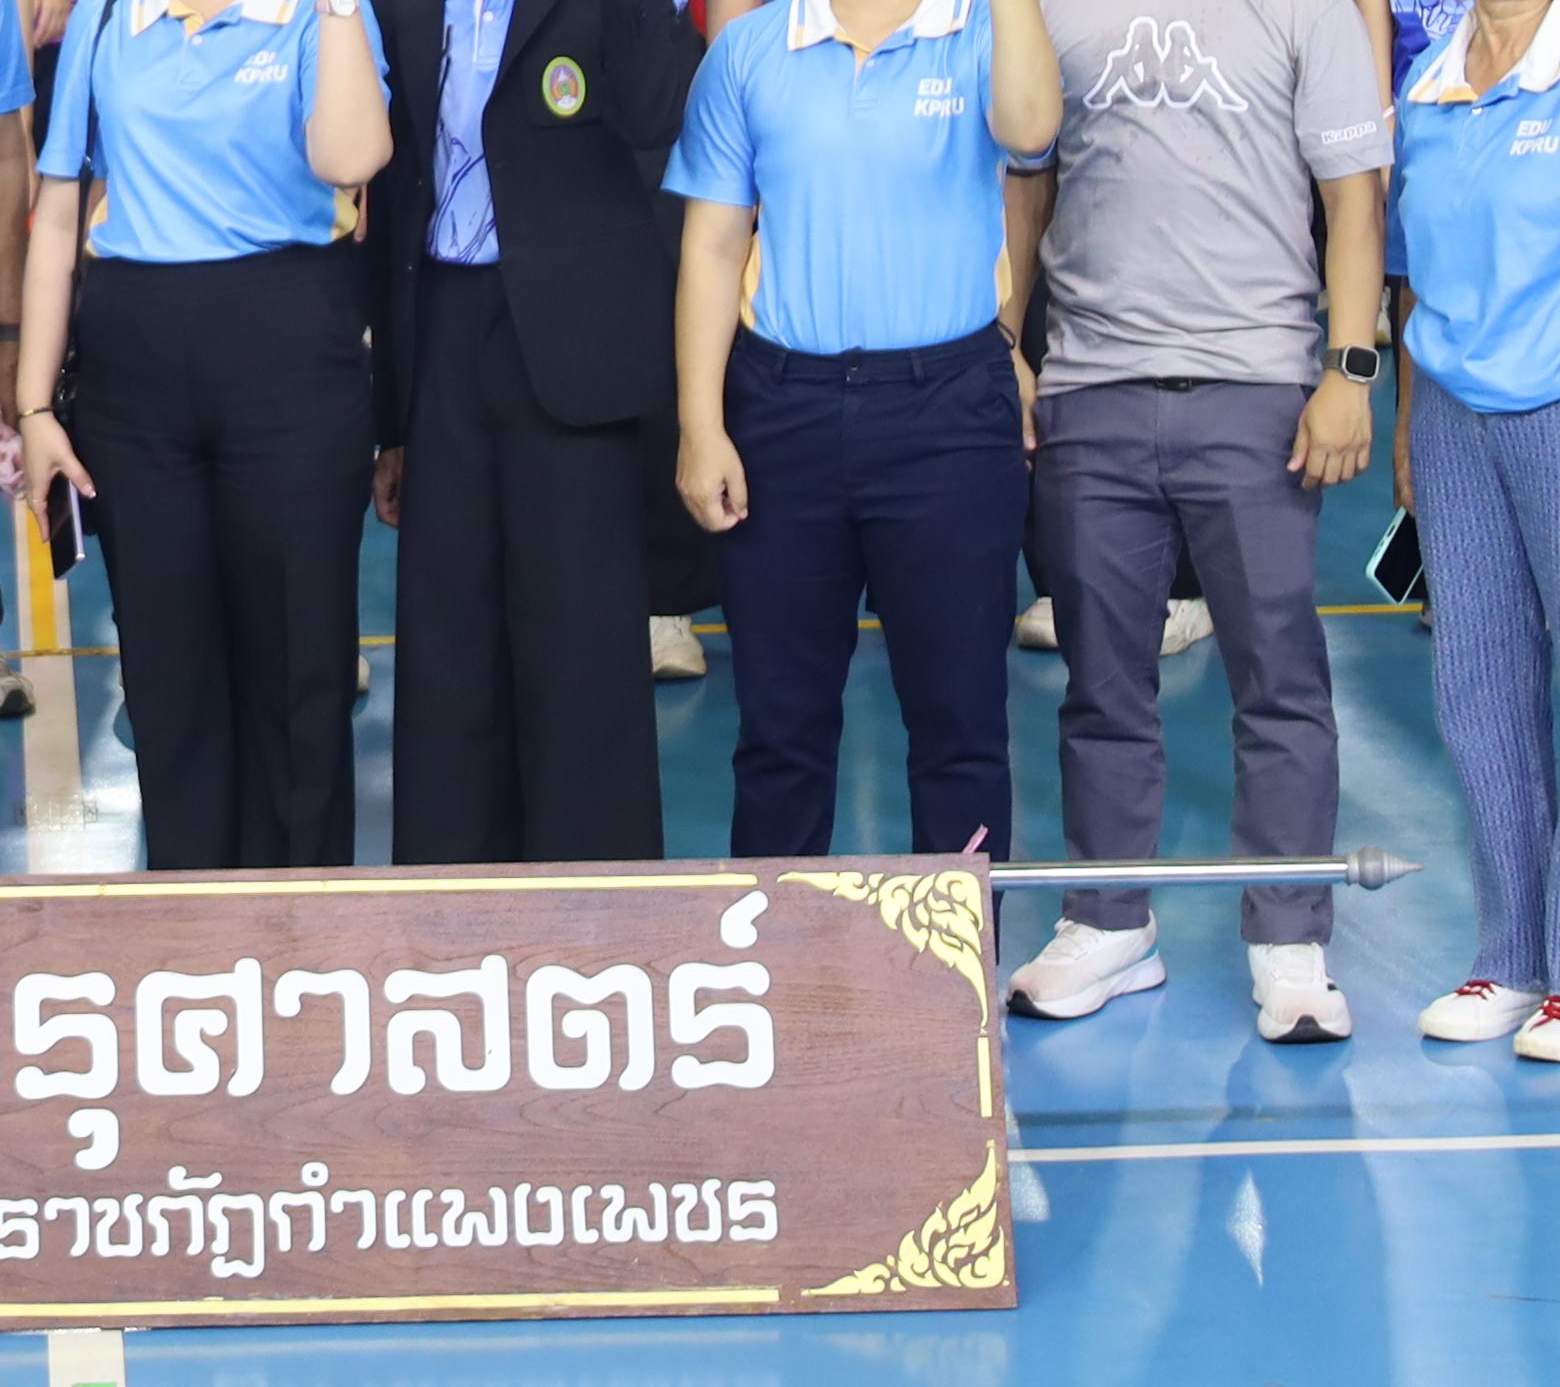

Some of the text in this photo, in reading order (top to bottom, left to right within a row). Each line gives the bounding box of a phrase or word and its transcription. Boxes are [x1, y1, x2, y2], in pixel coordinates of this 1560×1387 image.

[233, 64, 289, 85] KPRU
[913, 97, 965, 118] KPRU
[1509, 135, 1560, 156] KPRU
